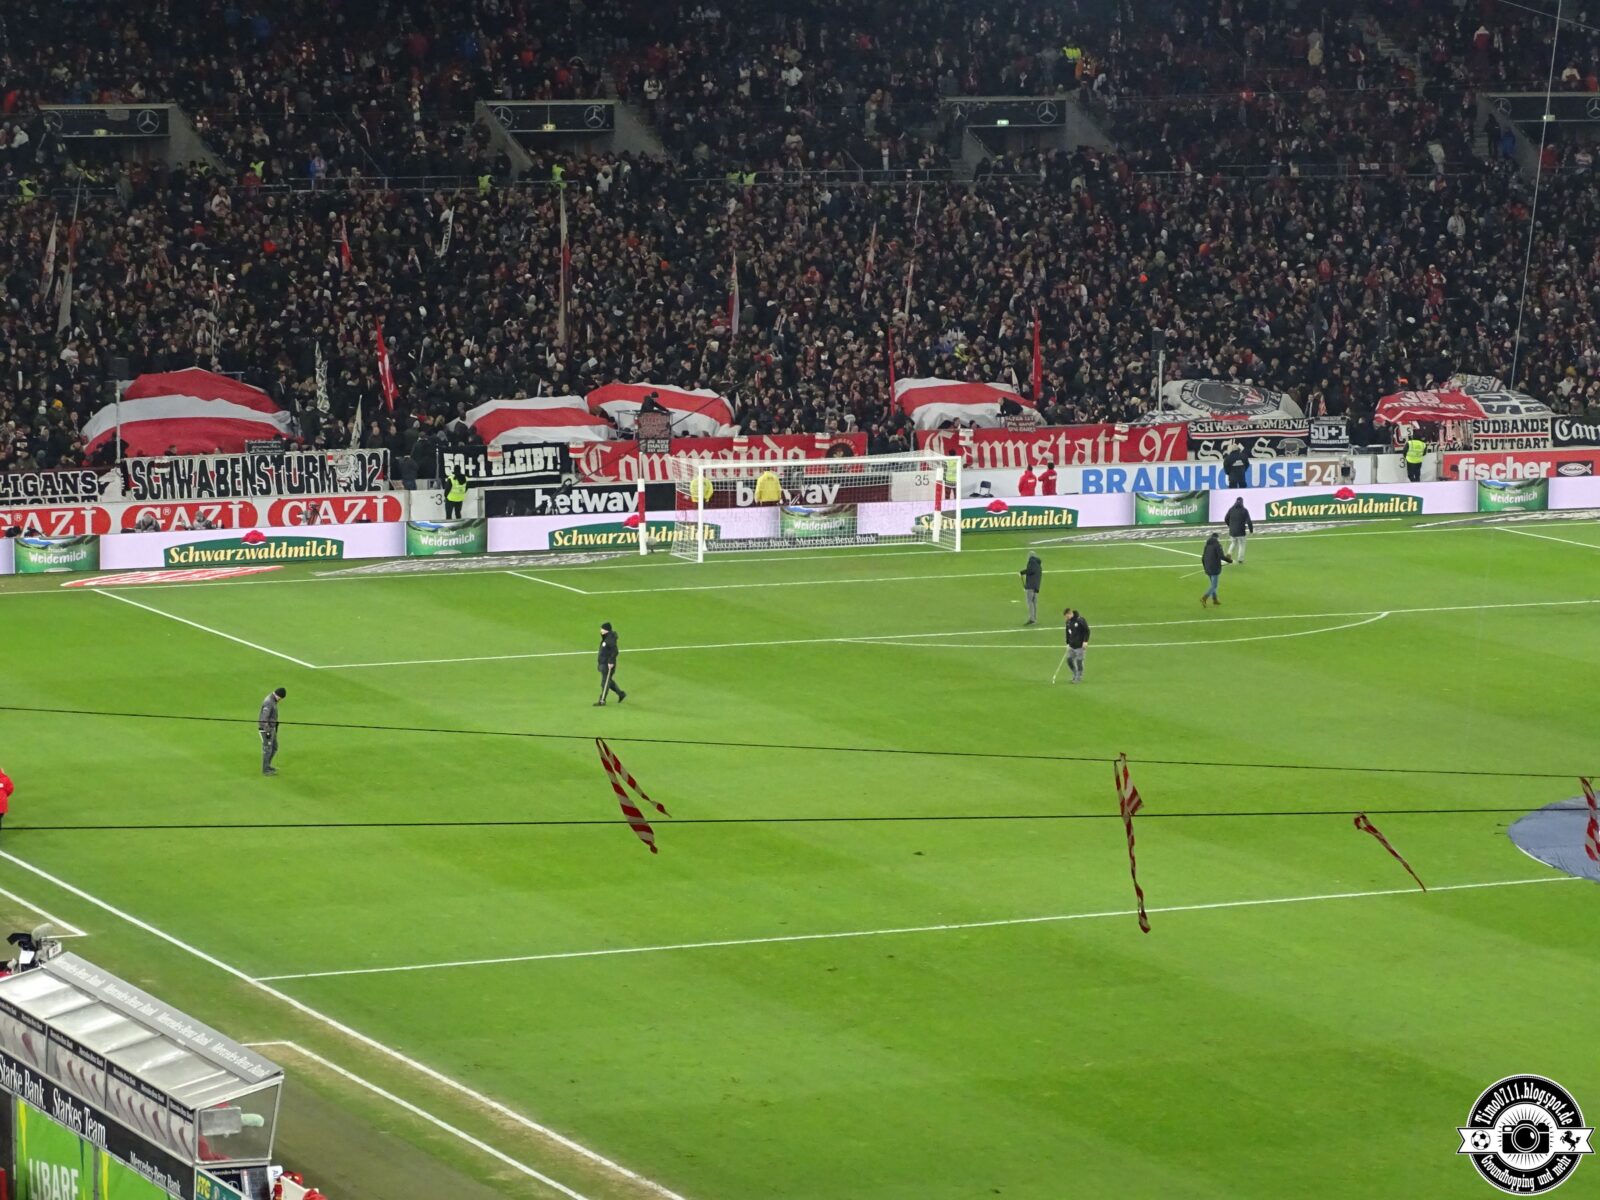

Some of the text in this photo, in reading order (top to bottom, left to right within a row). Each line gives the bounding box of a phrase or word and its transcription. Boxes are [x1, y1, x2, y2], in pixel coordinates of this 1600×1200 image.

[1310, 423, 1349, 440] 50+1
[1139, 427, 1181, 463] 97
[1474, 438, 1550, 450] STUTTGART
[131, 452, 384, 501] SCHWABENSTURM 02
[1458, 456, 1551, 481] fischer
[914, 474, 930, 487] 35
[535, 488, 640, 514] betway
[1490, 490, 1538, 503] Weidemilch
[1147, 503, 1198, 516] Weidemilch
[1270, 497, 1418, 518] Schwarzwaldmilch
[420, 532, 475, 547] Weidemilch
[28, 549, 87, 564] Weidemilch
[169, 540, 338, 563] Schwarzwaldmilch
[24, 1069, 47, 1110] Bank.
[52, 1087, 83, 1133] Starkes
[84, 1106, 108, 1149] Team.
